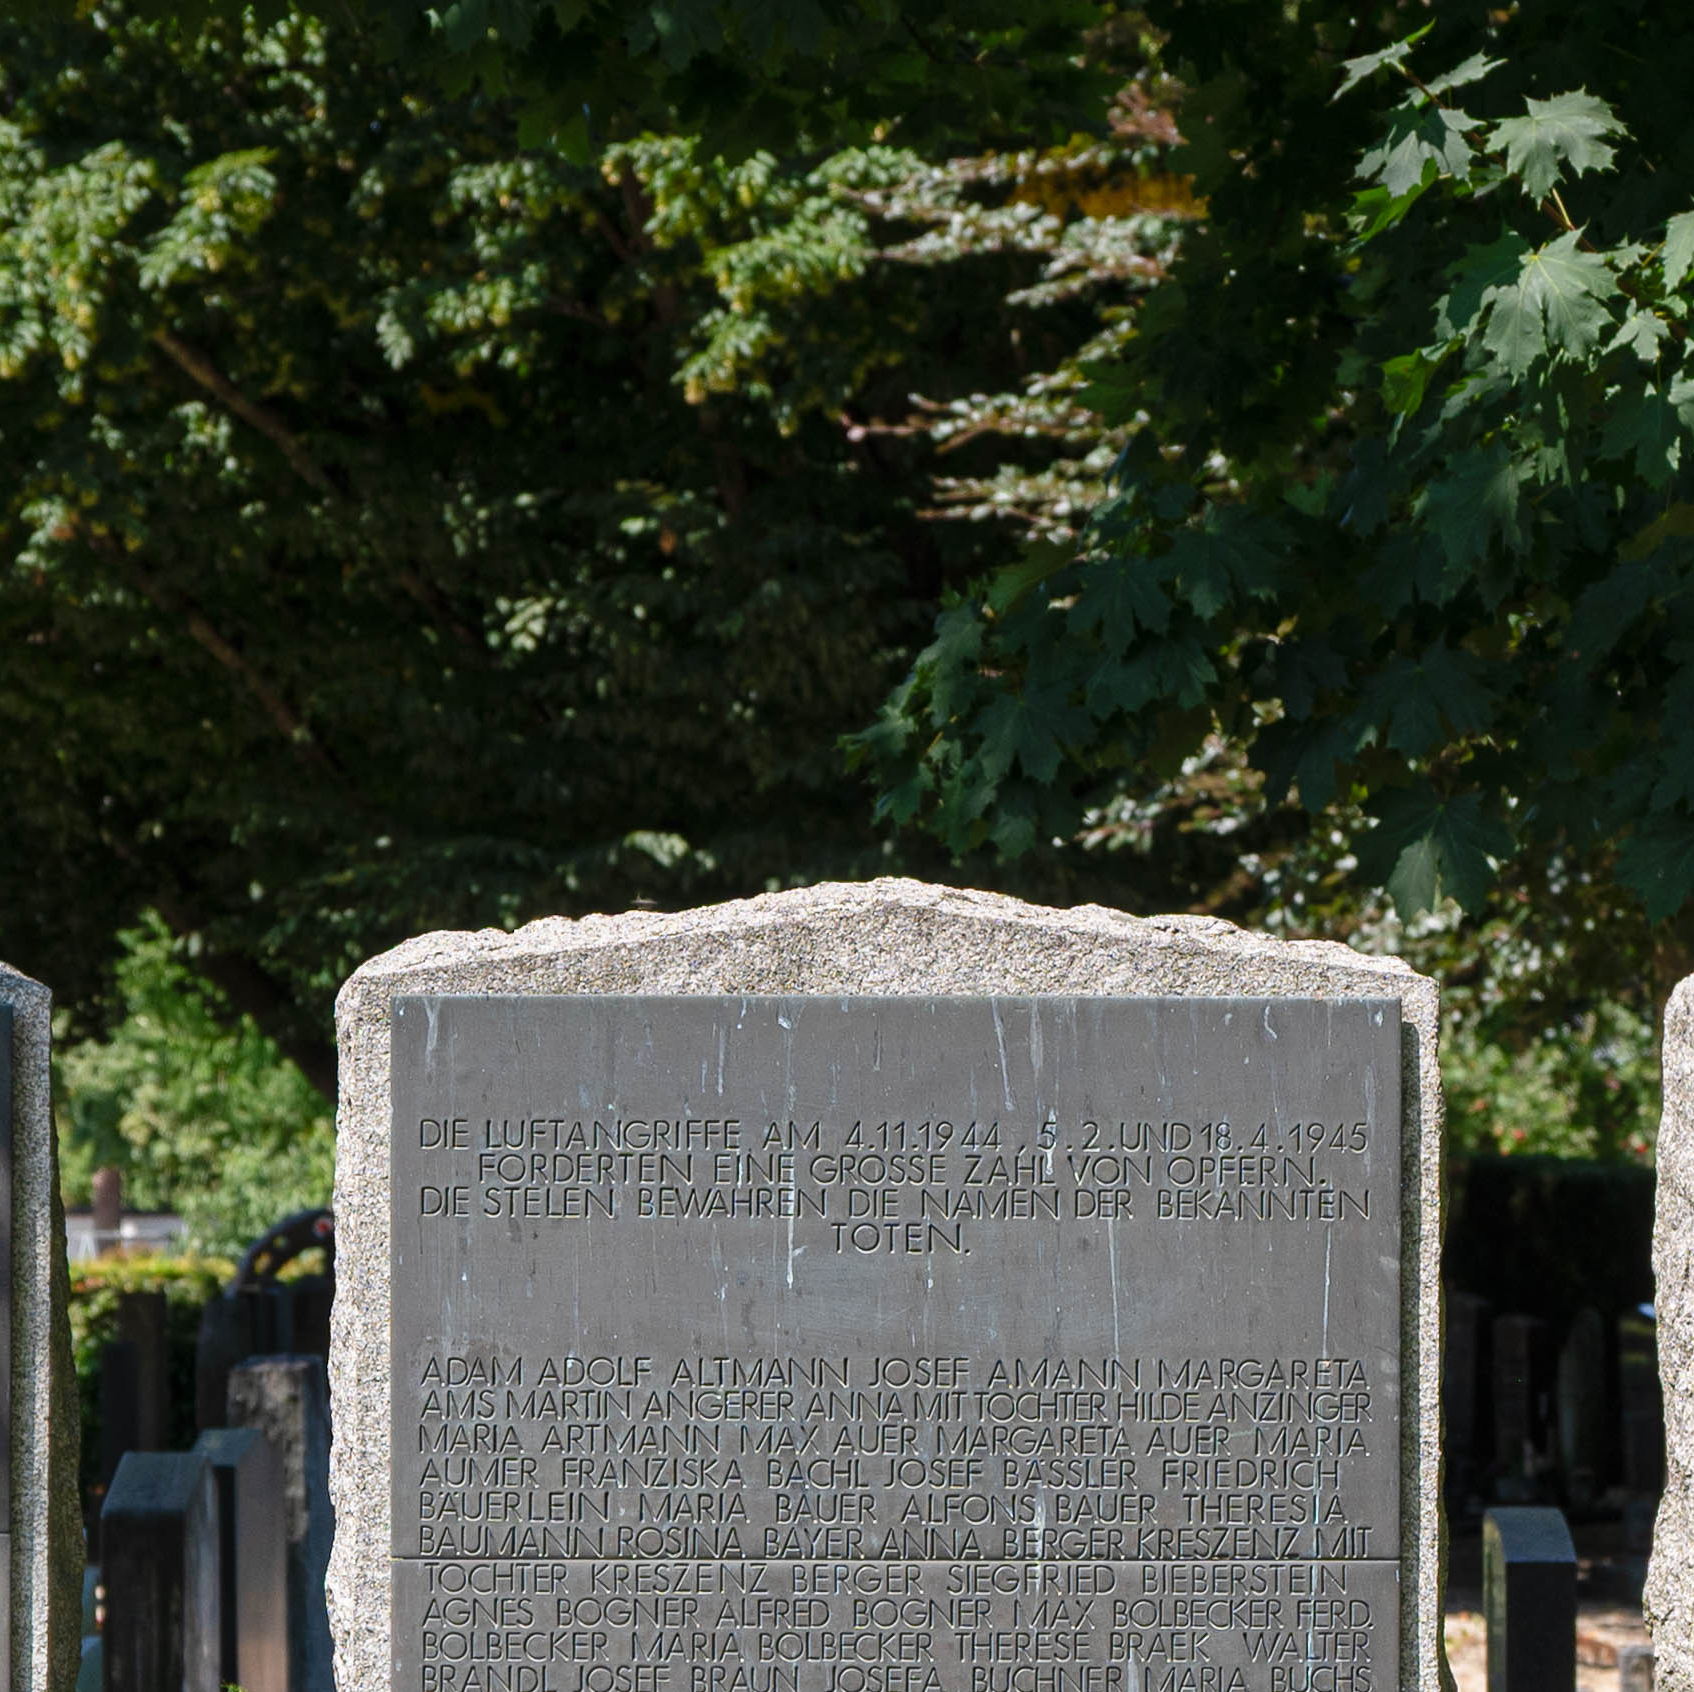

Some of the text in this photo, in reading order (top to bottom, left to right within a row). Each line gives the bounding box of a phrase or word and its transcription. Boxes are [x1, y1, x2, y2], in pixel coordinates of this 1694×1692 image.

[419, 1120, 469, 1150] DIE
[484, 1120, 742, 1151] LUFTANGRIFFE
[761, 1120, 822, 1151] AM
[478, 1154, 1328, 1186] FORDERTEN EINE GROSSE ZAHL VON OPFERN.
[420, 1187, 1371, 1220] DIE STELEN BEWAHREN DIE NAMEN DER BEKANNTEN
[830, 1223, 972, 1255] TOTEN.
[420, 1356, 1371, 1390] ADAM ADOLF ALTMANN JOSEF AMANN MARGARETA
[418, 1424, 1371, 1457] MARIA ARTMANN MAX AUER MARGARETA AUER MARIA
[419, 1457, 1342, 1490] AUMER FRANZISKA BACHL JOSEF BÄSSLER FRIEDRICH
[418, 1491, 1348, 1525] BÄUERLEIN MARIA BAUER ALFONS BAUER THERESIA
